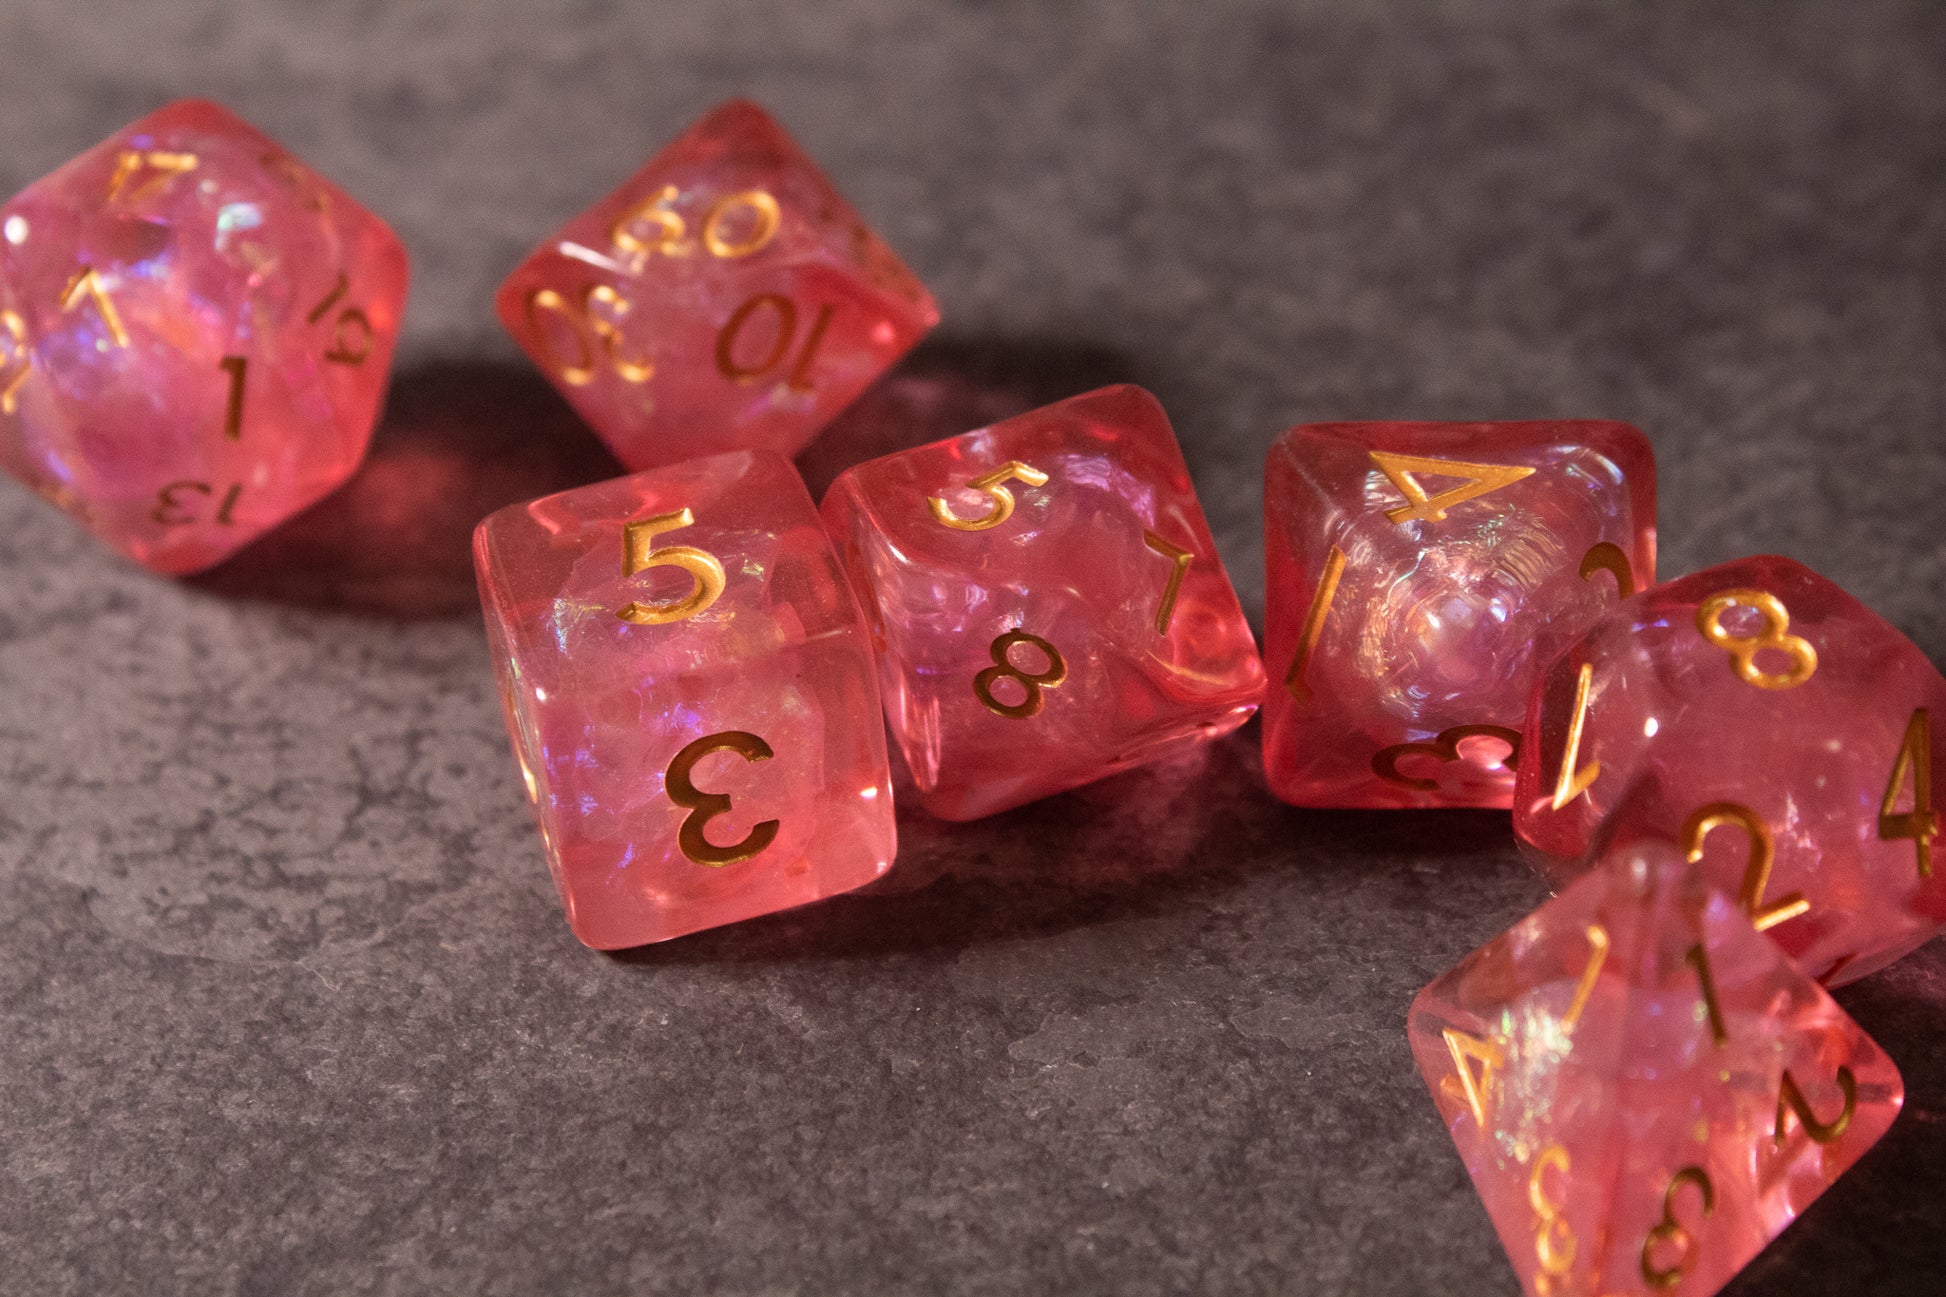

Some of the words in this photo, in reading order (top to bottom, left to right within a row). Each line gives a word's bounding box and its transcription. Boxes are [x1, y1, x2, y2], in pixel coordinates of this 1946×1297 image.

[715, 292, 836, 394] 10
[219, 355, 248, 442] 1
[150, 480, 243, 526] 13
[927, 460, 1049, 532] 5
[1369, 451, 1537, 525] 4
[616, 507, 727, 626] 5
[1143, 529, 1195, 638] 7
[972, 627, 1069, 720] 8
[1697, 588, 1819, 691] 8
[664, 730, 781, 868] 3
[1371, 724, 1525, 792] 3
[1879, 706, 1938, 878] 4
[1681, 802, 1811, 933] 2
[1686, 942, 1729, 1050] 1
[1441, 1027, 1504, 1133] 4
[1776, 1063, 1858, 1147] 2
[1642, 1165, 1716, 1291] 3
